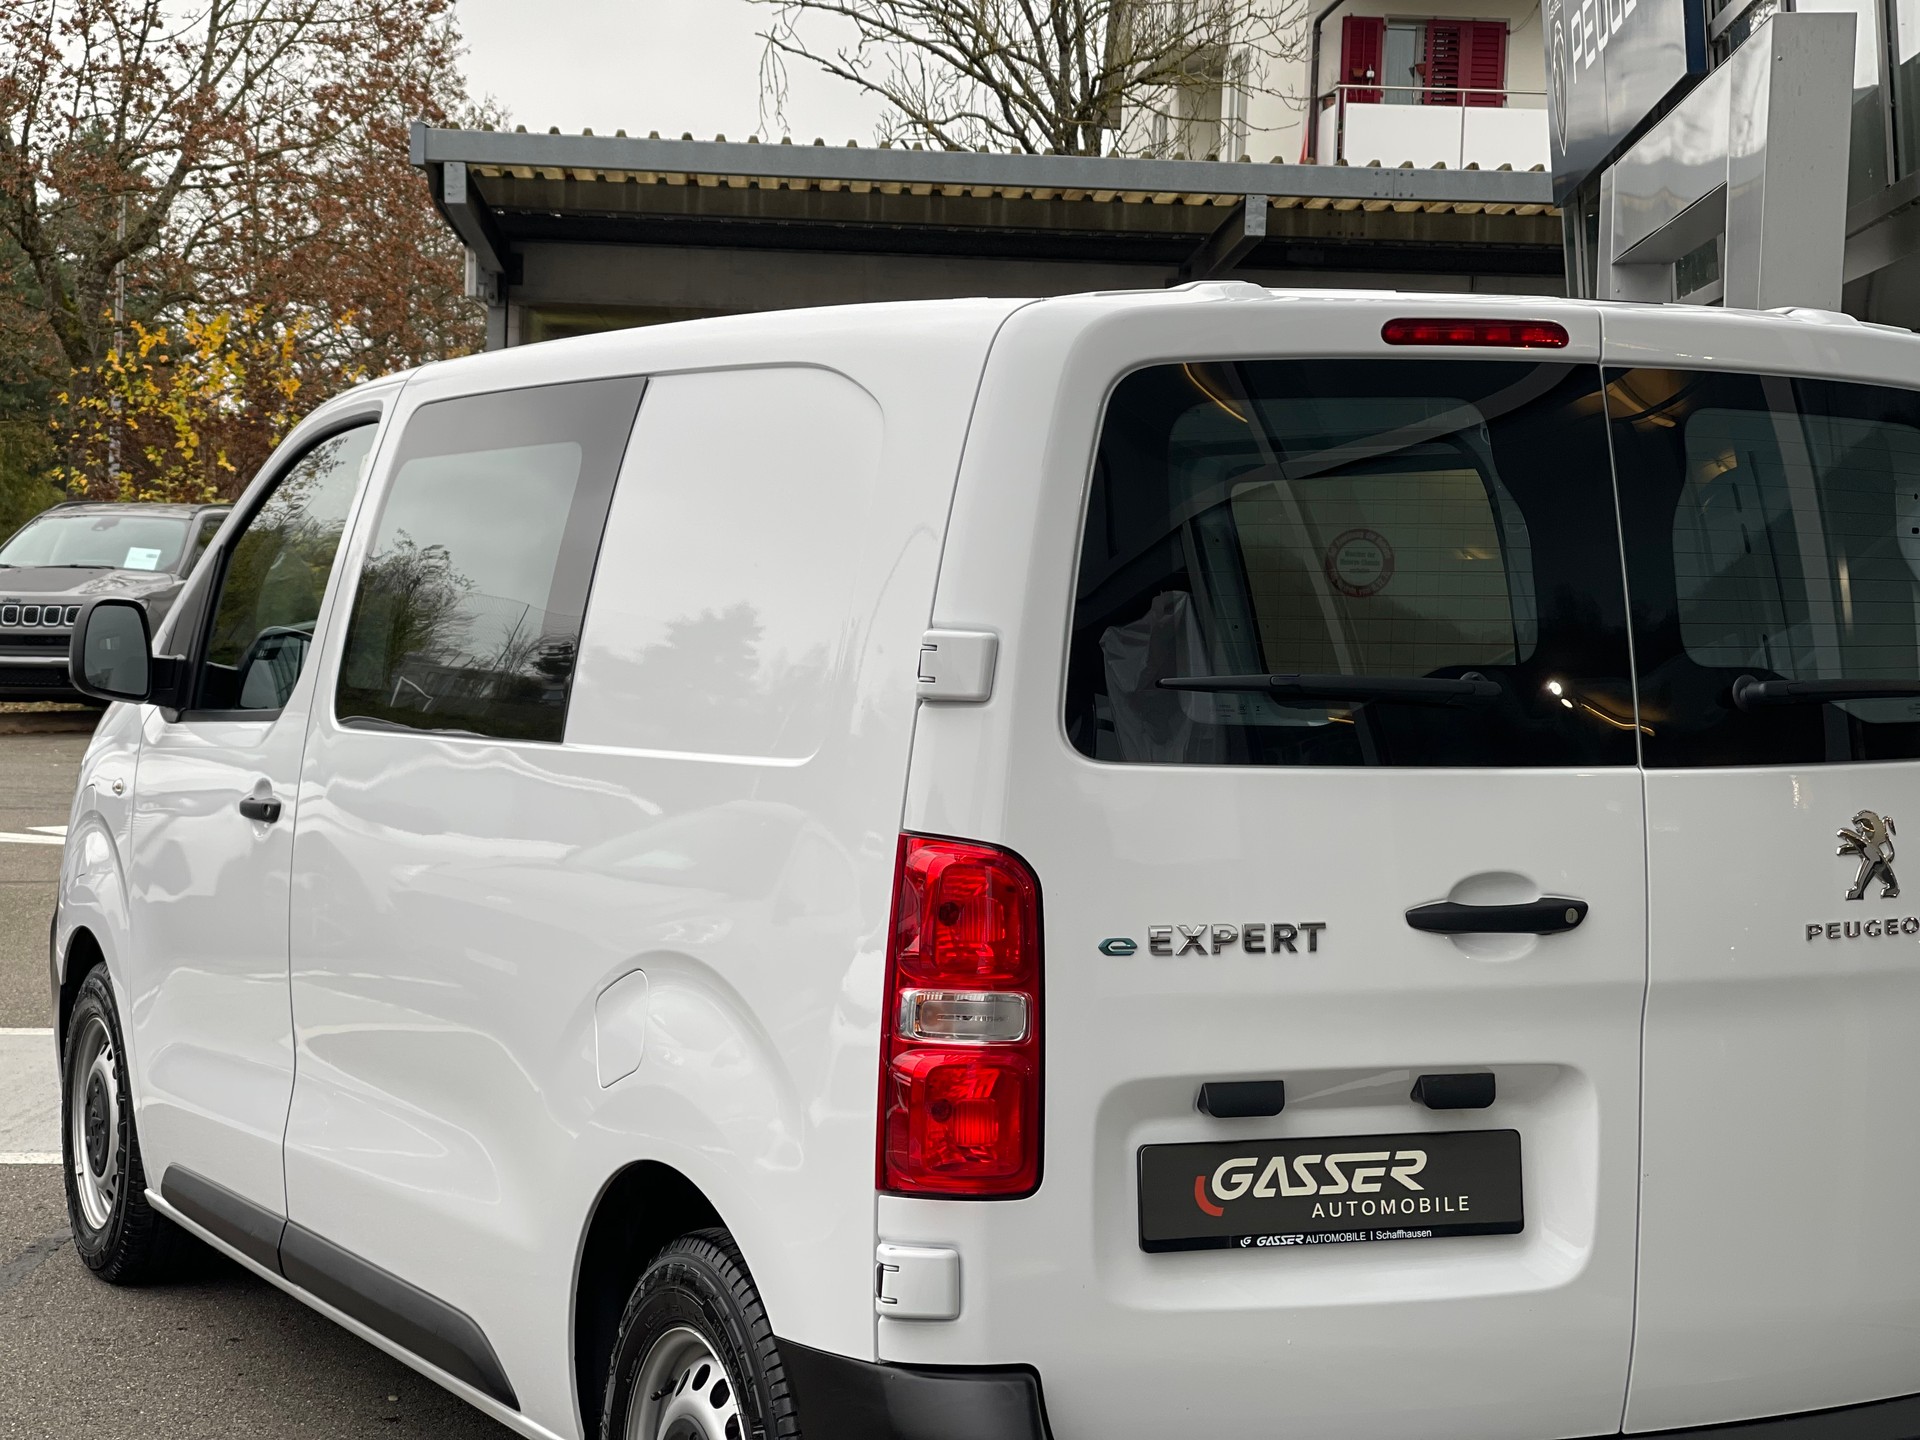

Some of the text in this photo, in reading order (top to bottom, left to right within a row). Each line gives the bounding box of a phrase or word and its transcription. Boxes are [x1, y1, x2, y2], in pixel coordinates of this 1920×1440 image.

[1148, 922, 1327, 956] EXPERT
[1806, 917, 1920, 941] PEUGEO
[1211, 1150, 1428, 1201] GASSER
[1311, 1196, 1470, 1219] AUTOMOBILE
[1256, 1234, 1304, 1247] GASSER
[1305, 1231, 1366, 1244] AUTOMOBILE
[1375, 1229, 1432, 1241] Schaffhausen
